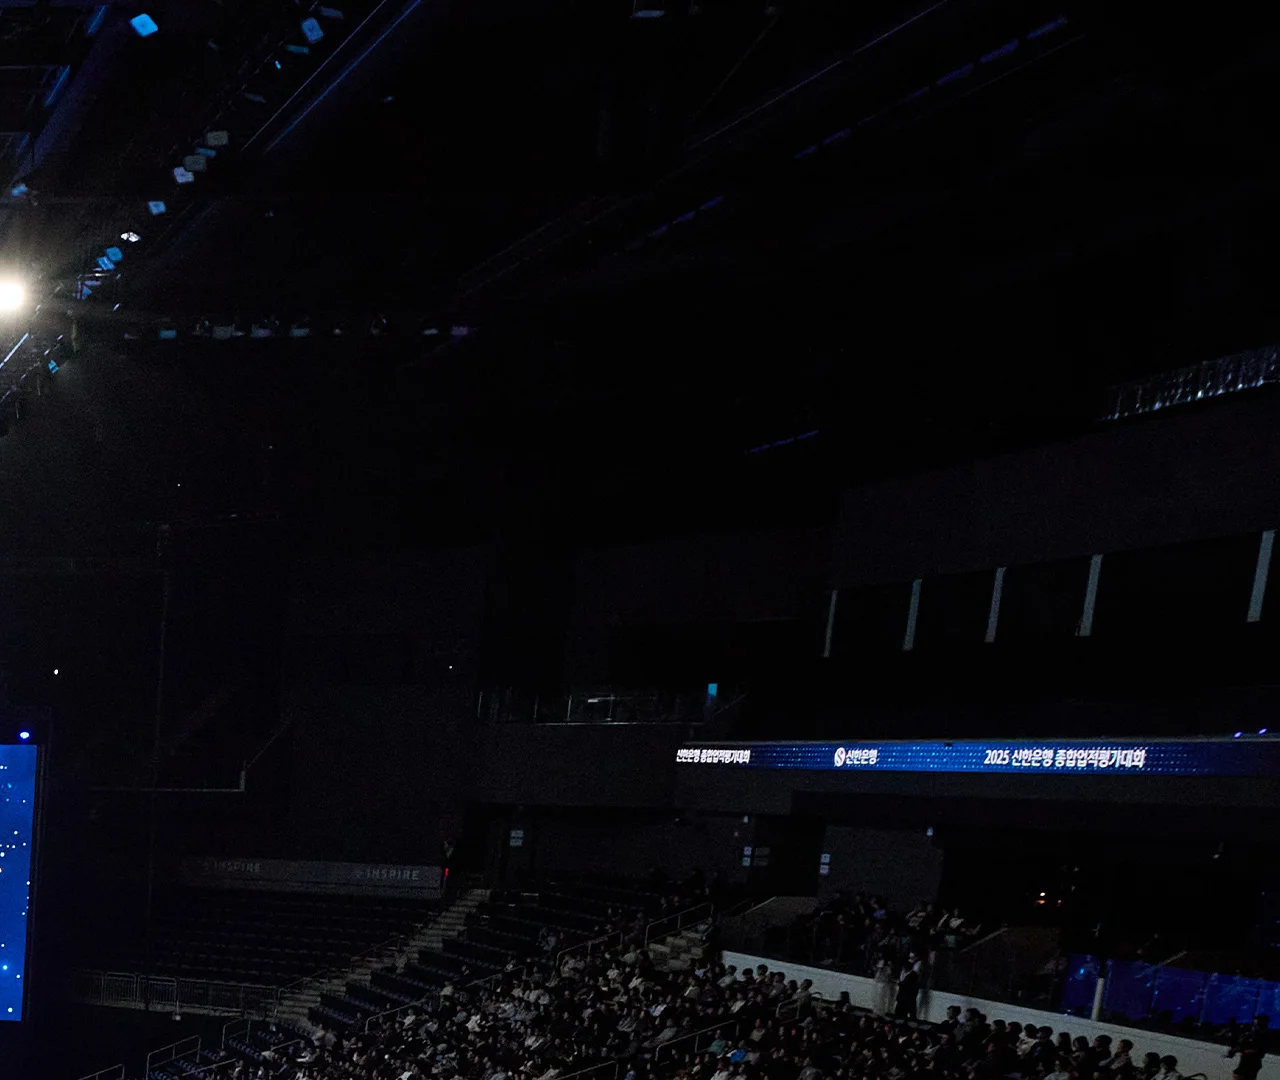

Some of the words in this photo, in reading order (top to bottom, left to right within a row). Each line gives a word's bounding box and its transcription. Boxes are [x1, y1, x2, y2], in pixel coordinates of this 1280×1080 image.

[845, 749, 878, 765] 신한은행
[984, 749, 1009, 765] 2025
[1011, 749, 1054, 767] 신한은행
[1055, 749, 1146, 768] 종합업적평가대회
